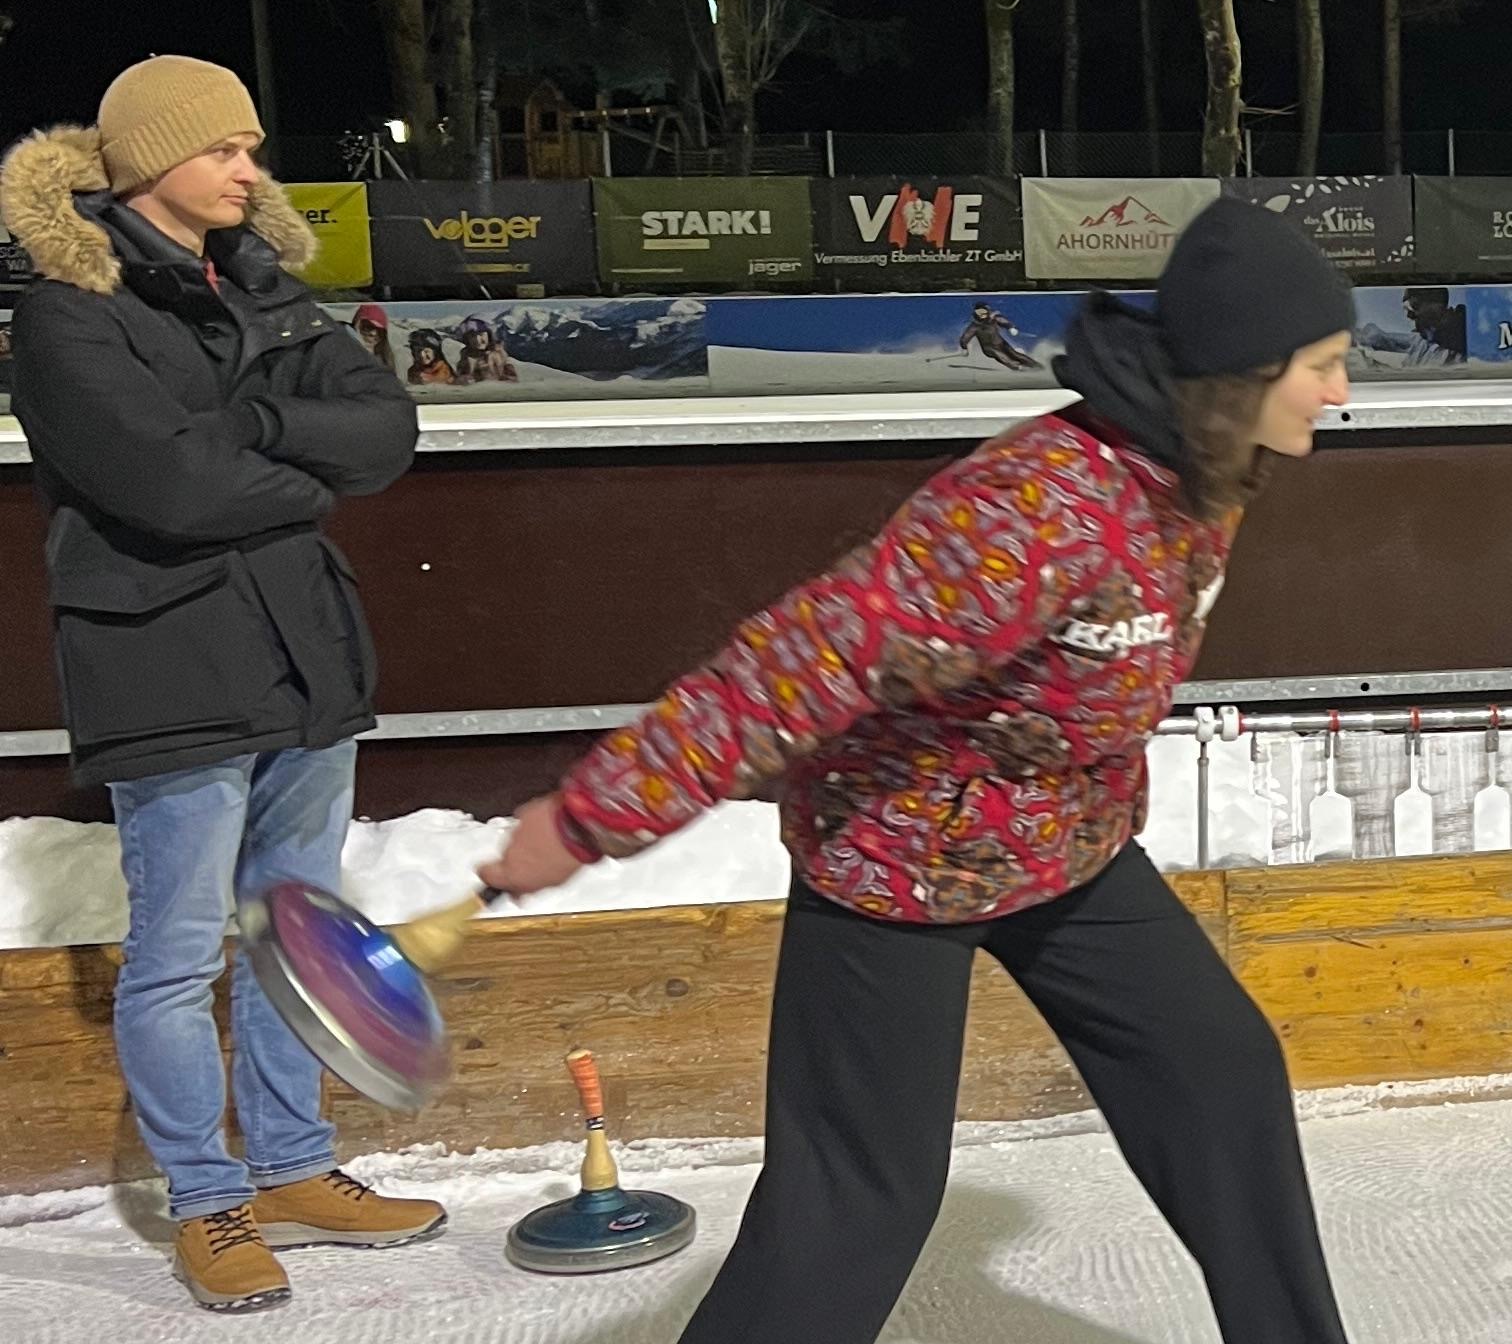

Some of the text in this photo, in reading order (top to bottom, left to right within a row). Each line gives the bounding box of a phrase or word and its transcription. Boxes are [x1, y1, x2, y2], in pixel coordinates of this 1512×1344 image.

[641, 210, 772, 236] STARK!
[815, 253, 888, 267] Vermessung
[965, 250, 982, 261] ZT
[984, 250, 1023, 262] GmbH
